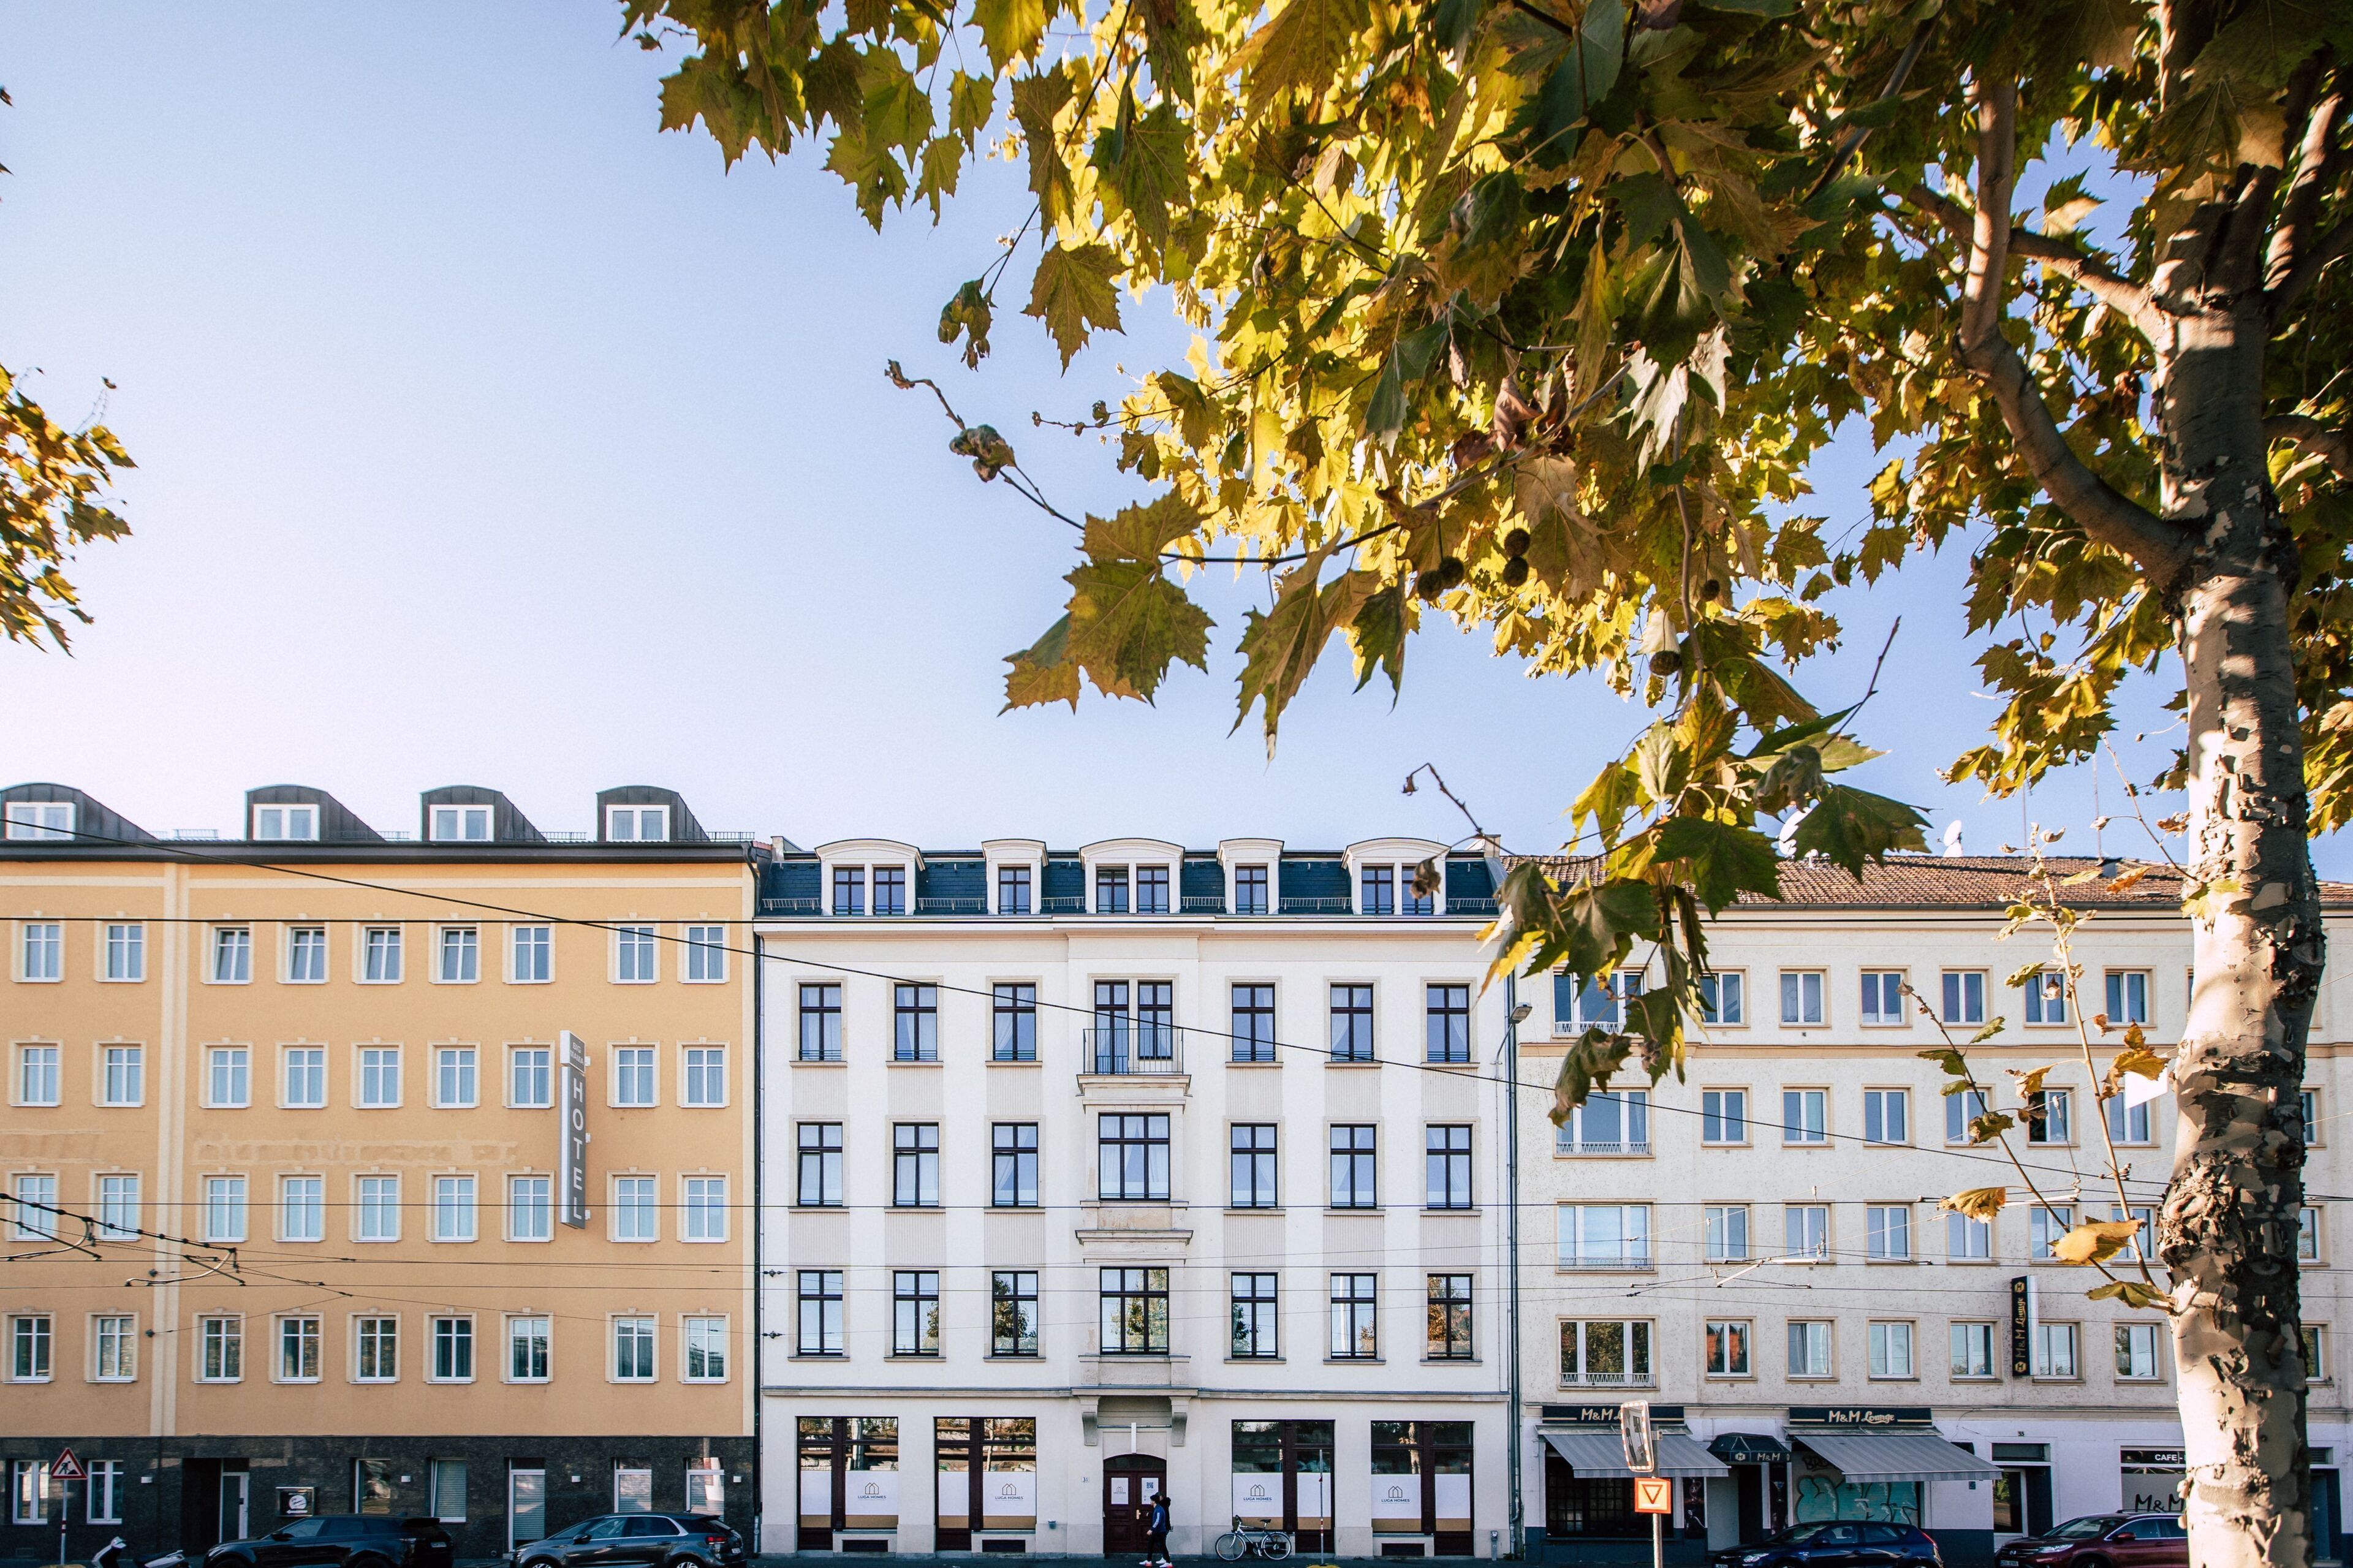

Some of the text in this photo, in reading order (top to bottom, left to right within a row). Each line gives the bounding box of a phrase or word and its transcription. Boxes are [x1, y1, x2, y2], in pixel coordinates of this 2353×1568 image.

[572, 1077, 583, 1220] HOTEL
[2015, 1297, 2026, 1358] M&M Lounge
[1581, 1408, 1613, 1421] M&M
[1828, 1411, 1895, 1424] M&M Lounge
[2135, 1493, 2184, 1512] M&M
